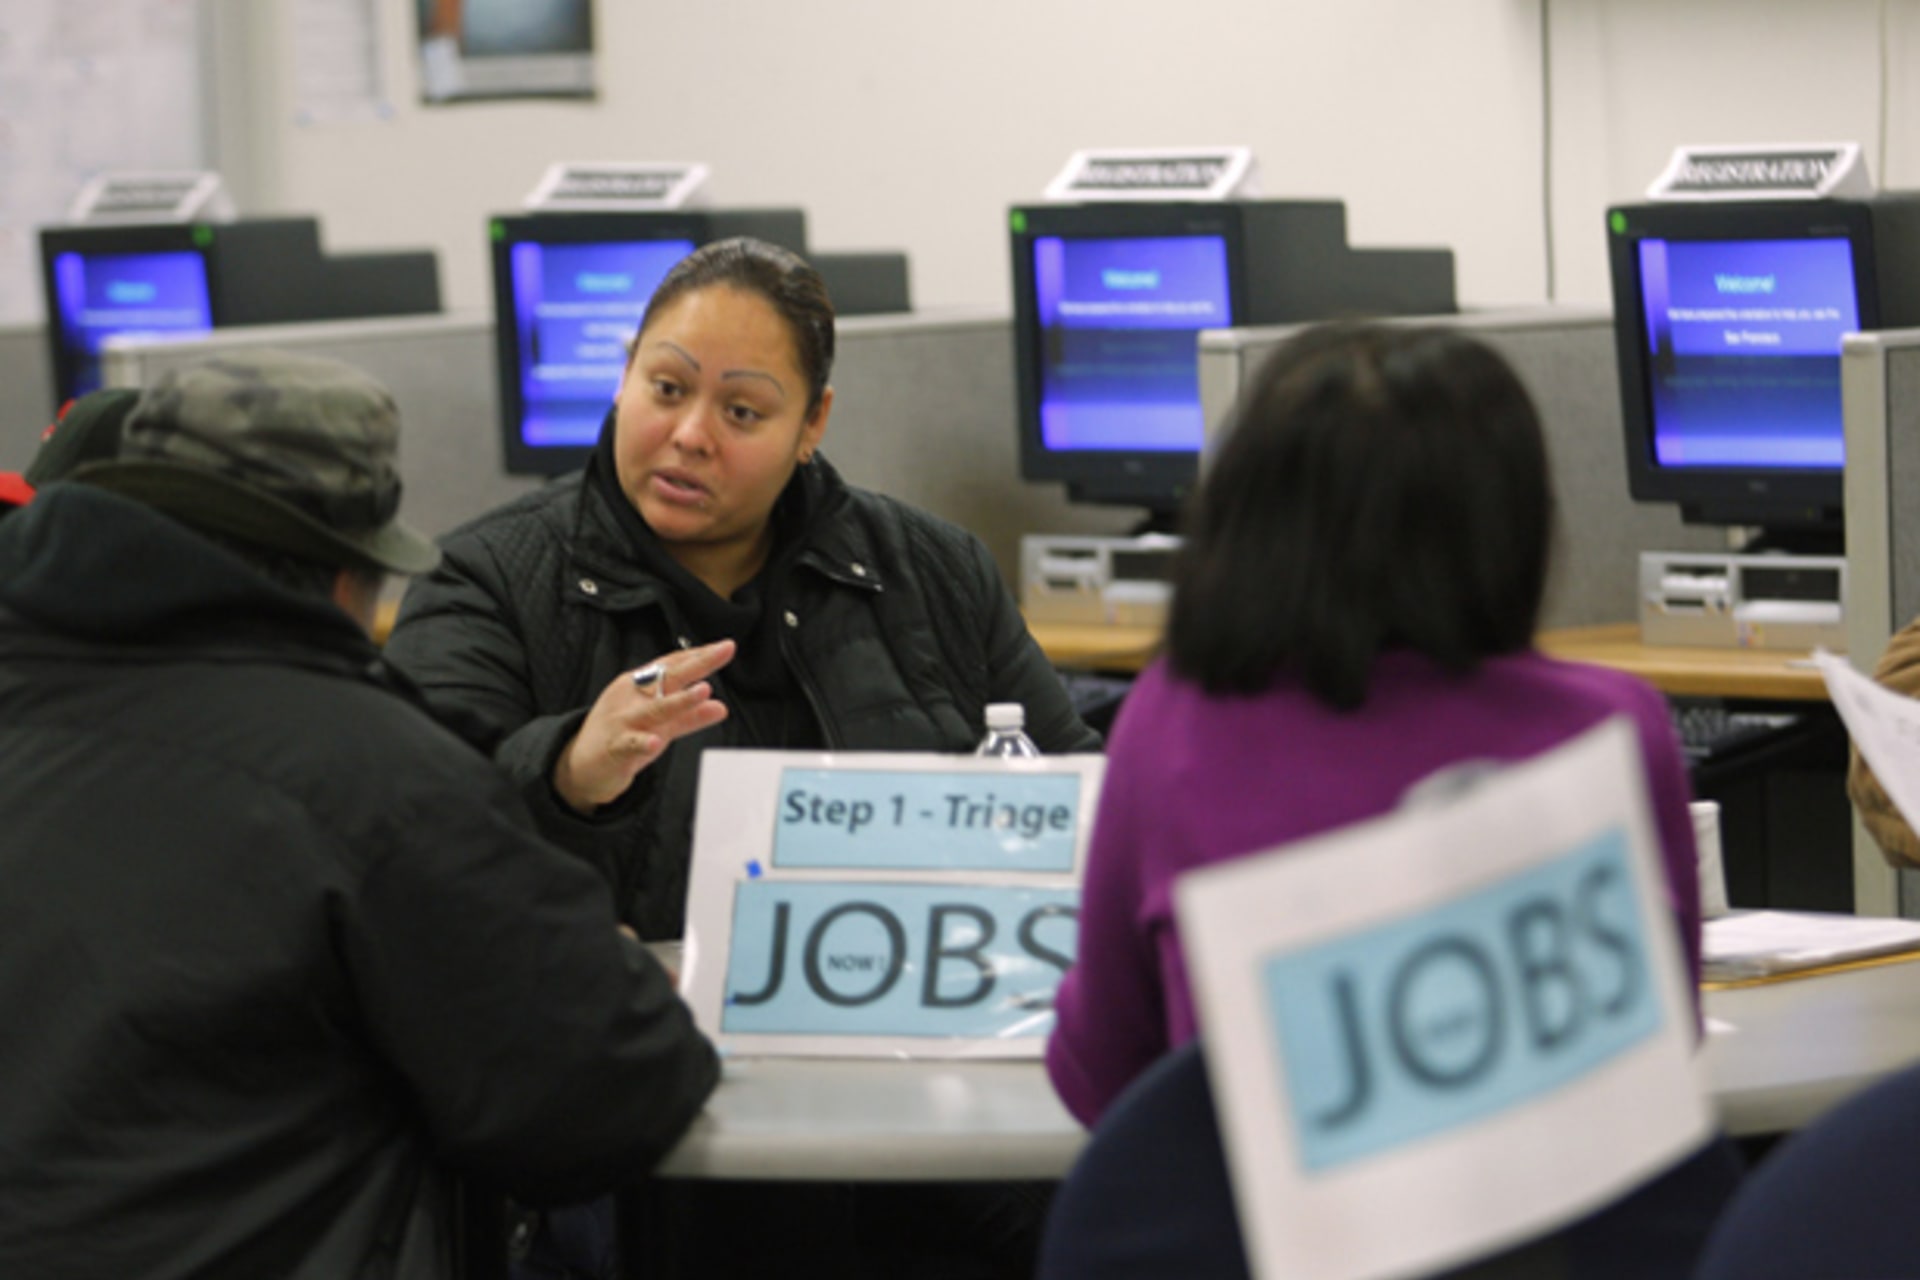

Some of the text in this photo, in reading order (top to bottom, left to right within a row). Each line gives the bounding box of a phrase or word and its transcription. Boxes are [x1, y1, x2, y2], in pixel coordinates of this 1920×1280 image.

[784, 789, 874, 834] Step
[889, 794, 905, 827] 1
[944, 793, 1071, 840] Triage
[730, 901, 1081, 1011] JOBS
[1308, 861, 1640, 1132] JOBS
